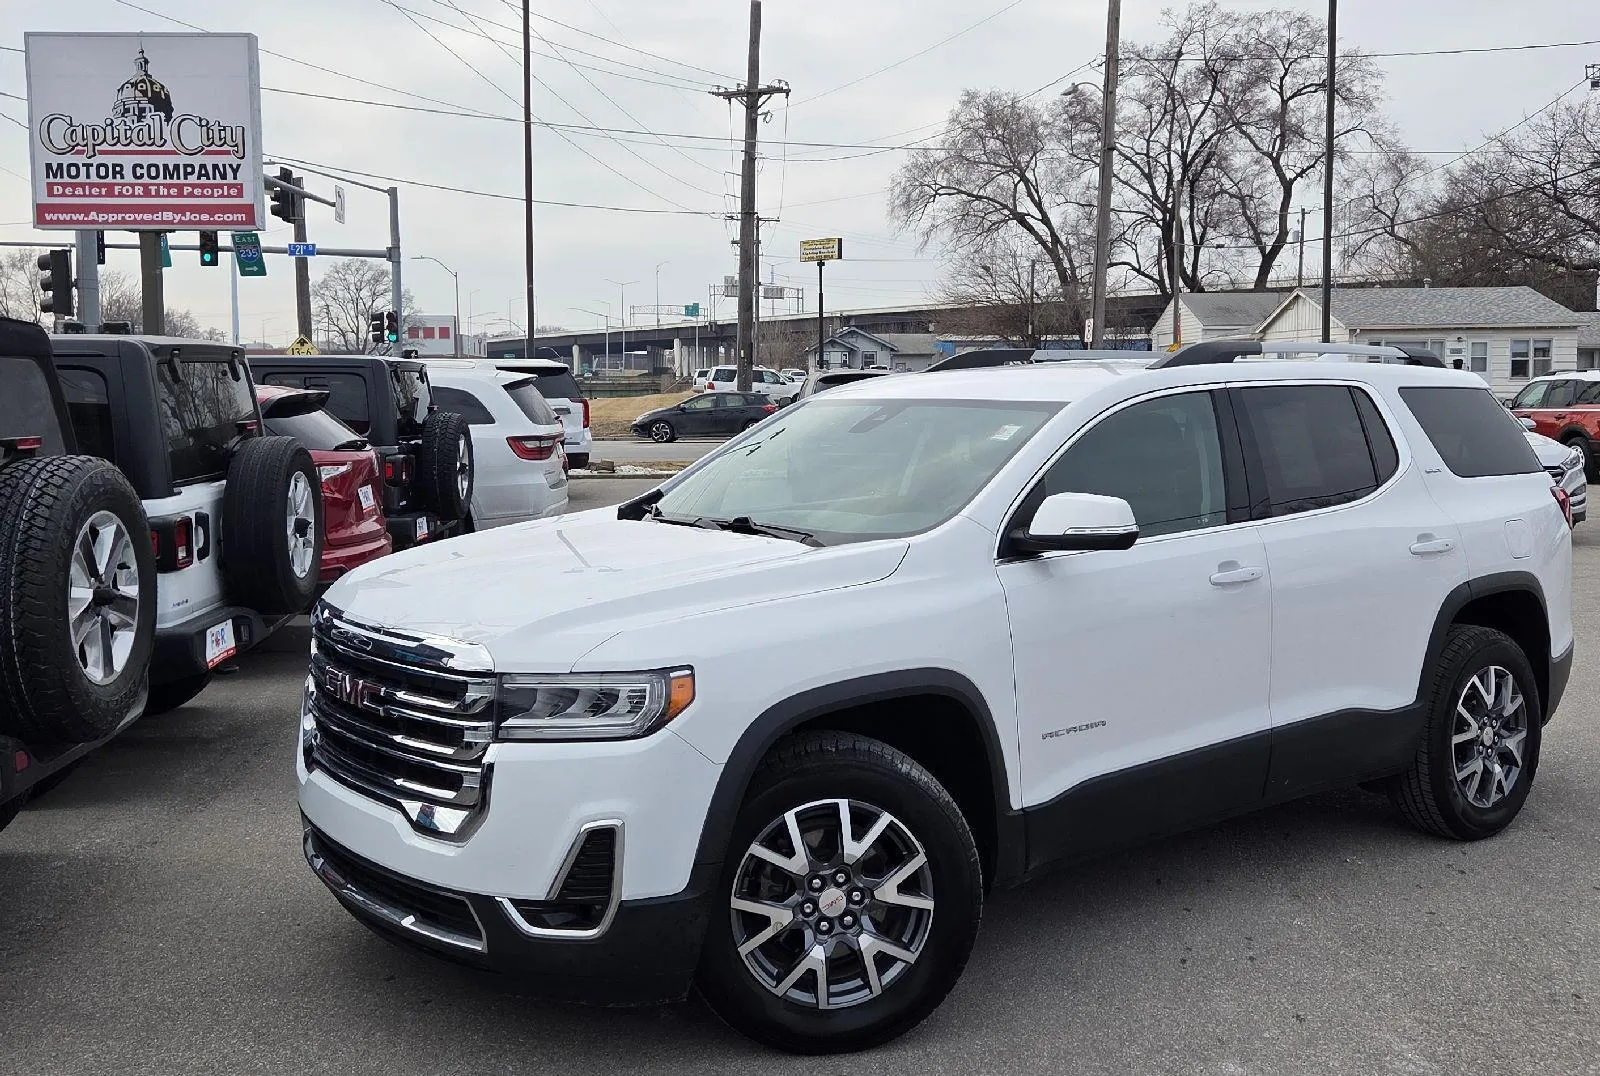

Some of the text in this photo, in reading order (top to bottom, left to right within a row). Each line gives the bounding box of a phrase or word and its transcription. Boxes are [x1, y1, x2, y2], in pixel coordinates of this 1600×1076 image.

[39, 113, 246, 159] Capital City
[45, 162, 242, 181] MOTOR COMPANY
[53, 185, 239, 198] Dealer FOR The People
[44, 211, 246, 224] www.ApprovedByJoe.com
[239, 249, 259, 258] 235
[325, 665, 387, 717] GMC
[1041, 720, 1107, 740] ACADIA
